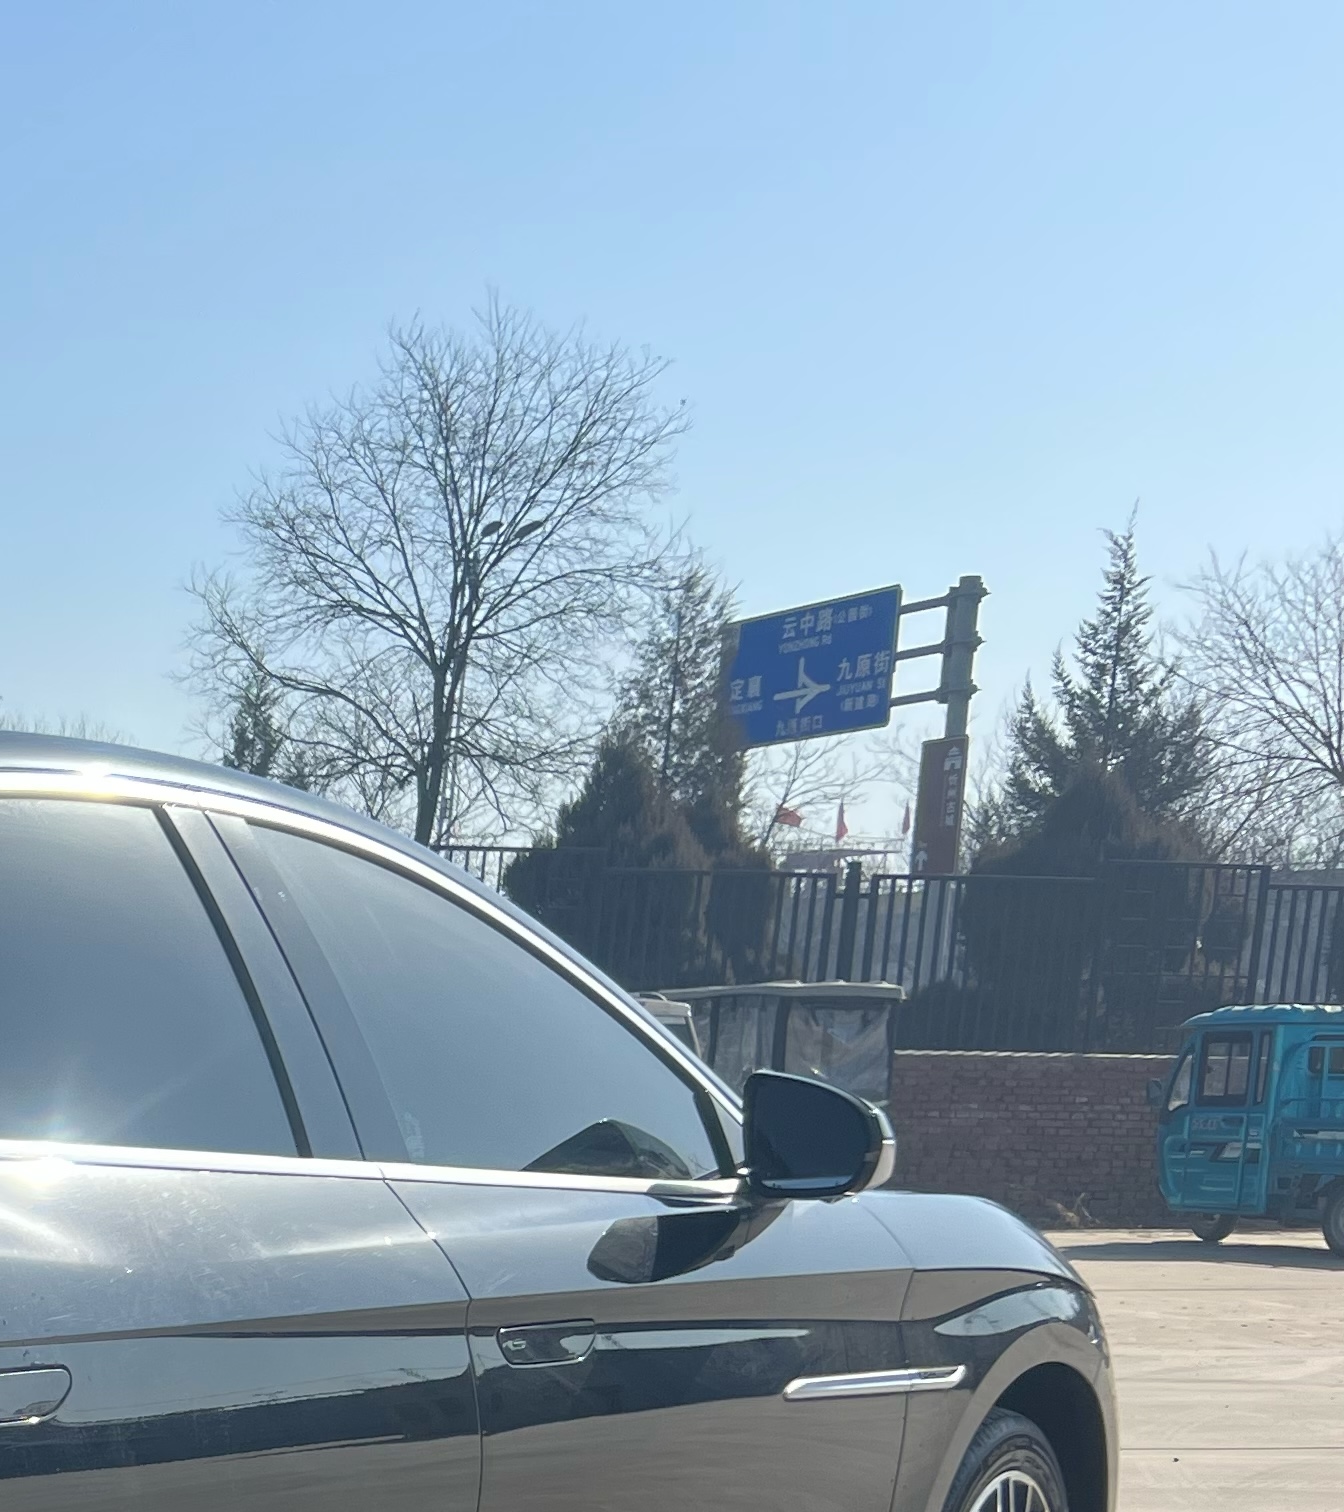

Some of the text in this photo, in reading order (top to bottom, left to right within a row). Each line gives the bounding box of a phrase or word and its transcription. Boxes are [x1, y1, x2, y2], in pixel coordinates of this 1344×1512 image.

[781, 607, 833, 639] 云中路
[837, 650, 890, 681] 九原街
